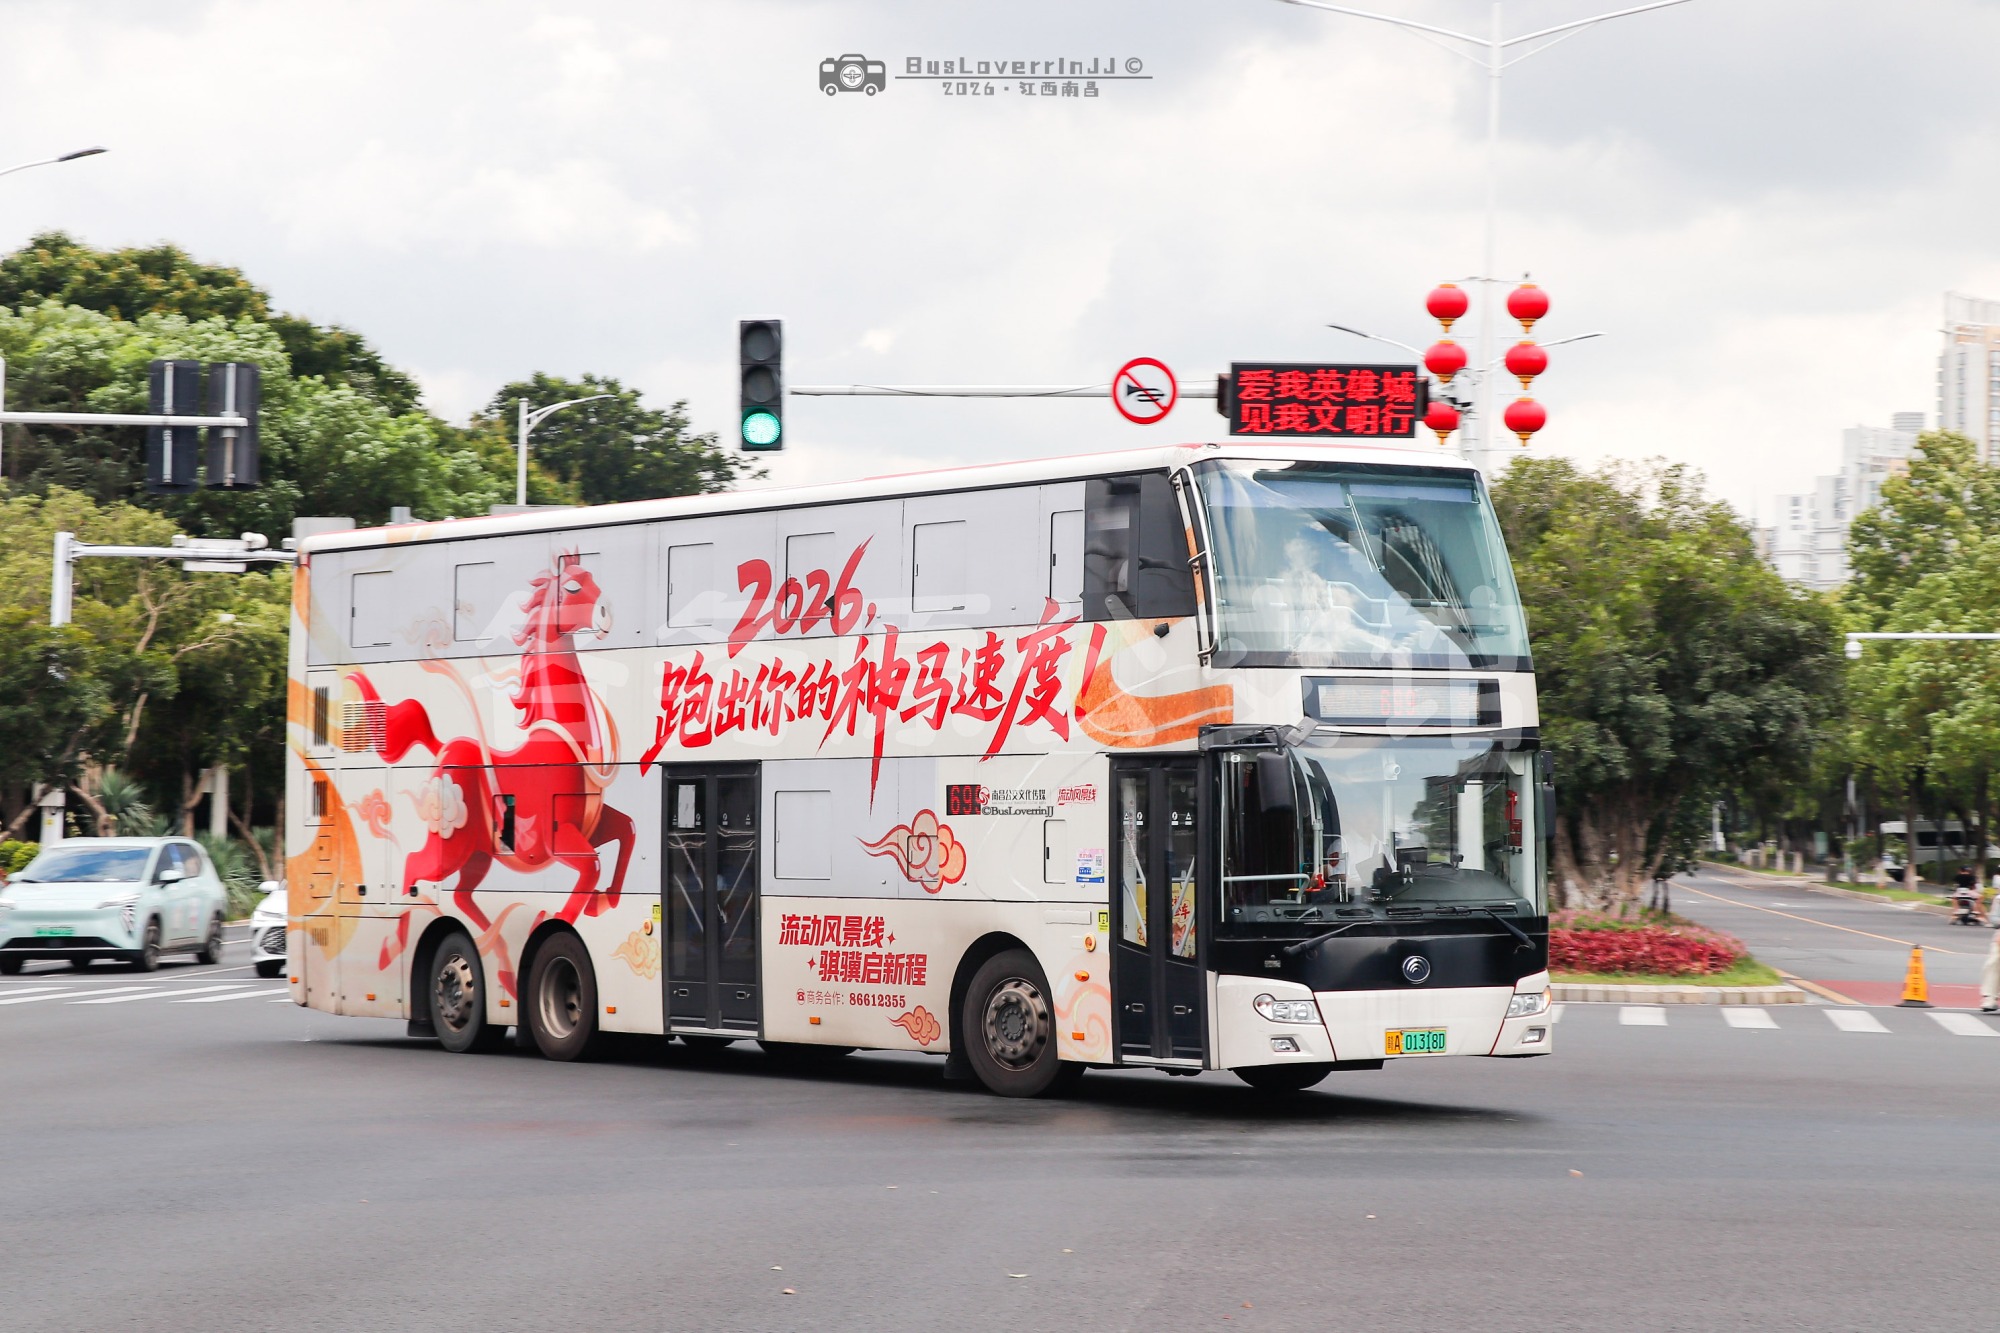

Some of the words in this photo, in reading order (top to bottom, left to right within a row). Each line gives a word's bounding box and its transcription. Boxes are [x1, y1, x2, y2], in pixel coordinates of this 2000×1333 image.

[1237, 369, 1416, 402] 爱我英雄城
[1236, 401, 1414, 434] 见我文明行
[992, 789, 1046, 801] 南昌公交文化传媒
[779, 914, 885, 948] 流动风景线
[818, 950, 928, 986] 骐骥启新程
